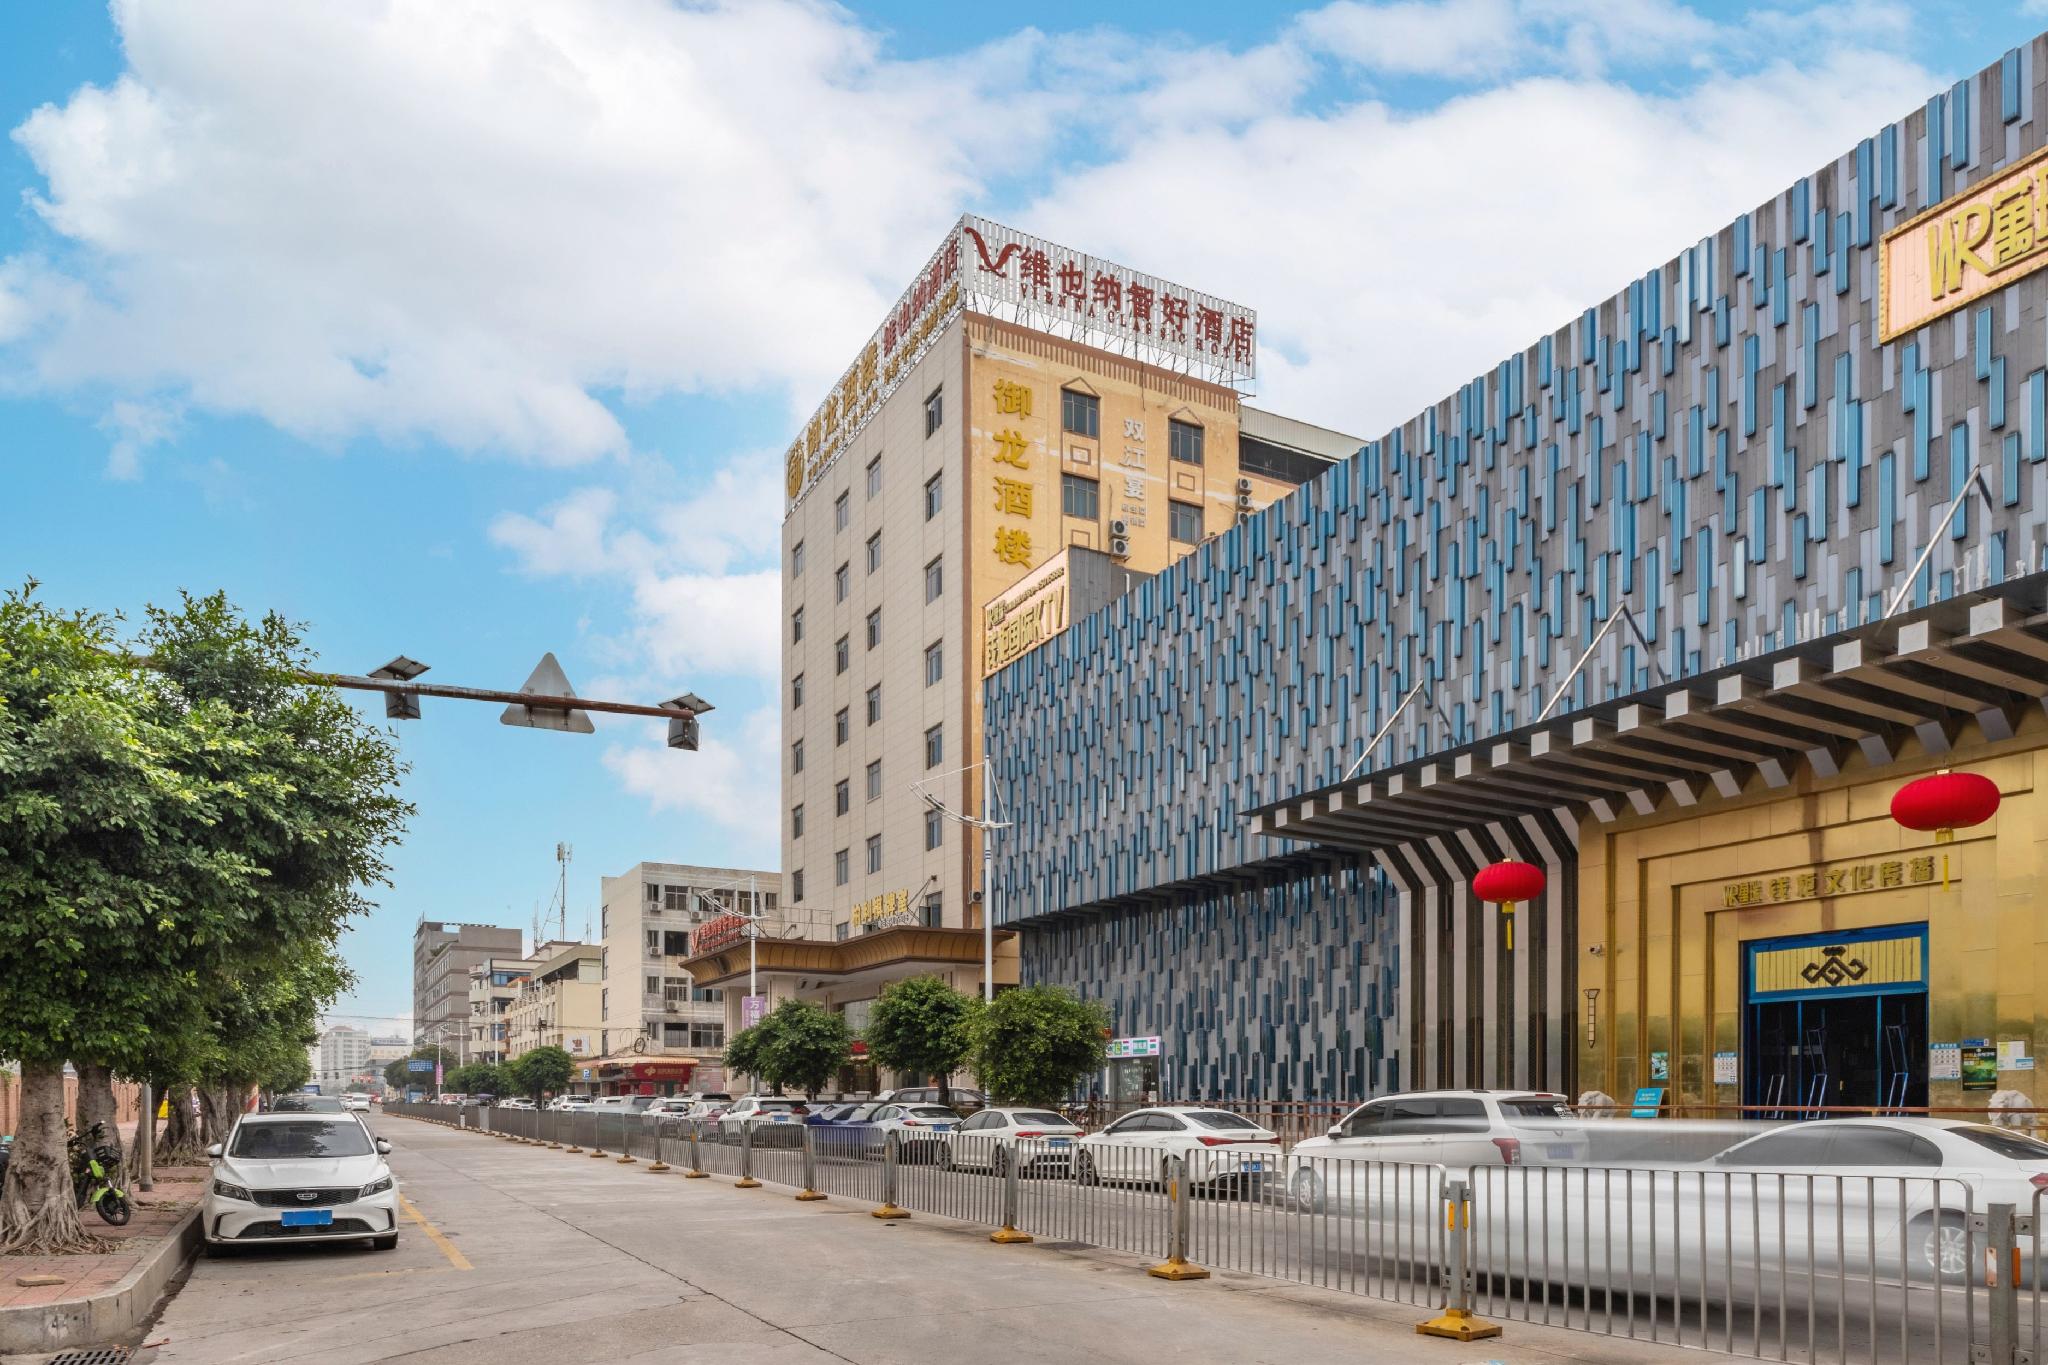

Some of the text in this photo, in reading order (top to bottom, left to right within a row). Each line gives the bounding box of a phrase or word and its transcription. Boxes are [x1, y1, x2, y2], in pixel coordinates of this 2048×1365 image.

[1019, 246, 1254, 349] 维也纳智好酒店
[1020, 283, 1252, 367] VIENNA CLASSIC HOTEL
[992, 377, 1033, 570] 御龙酒楼
